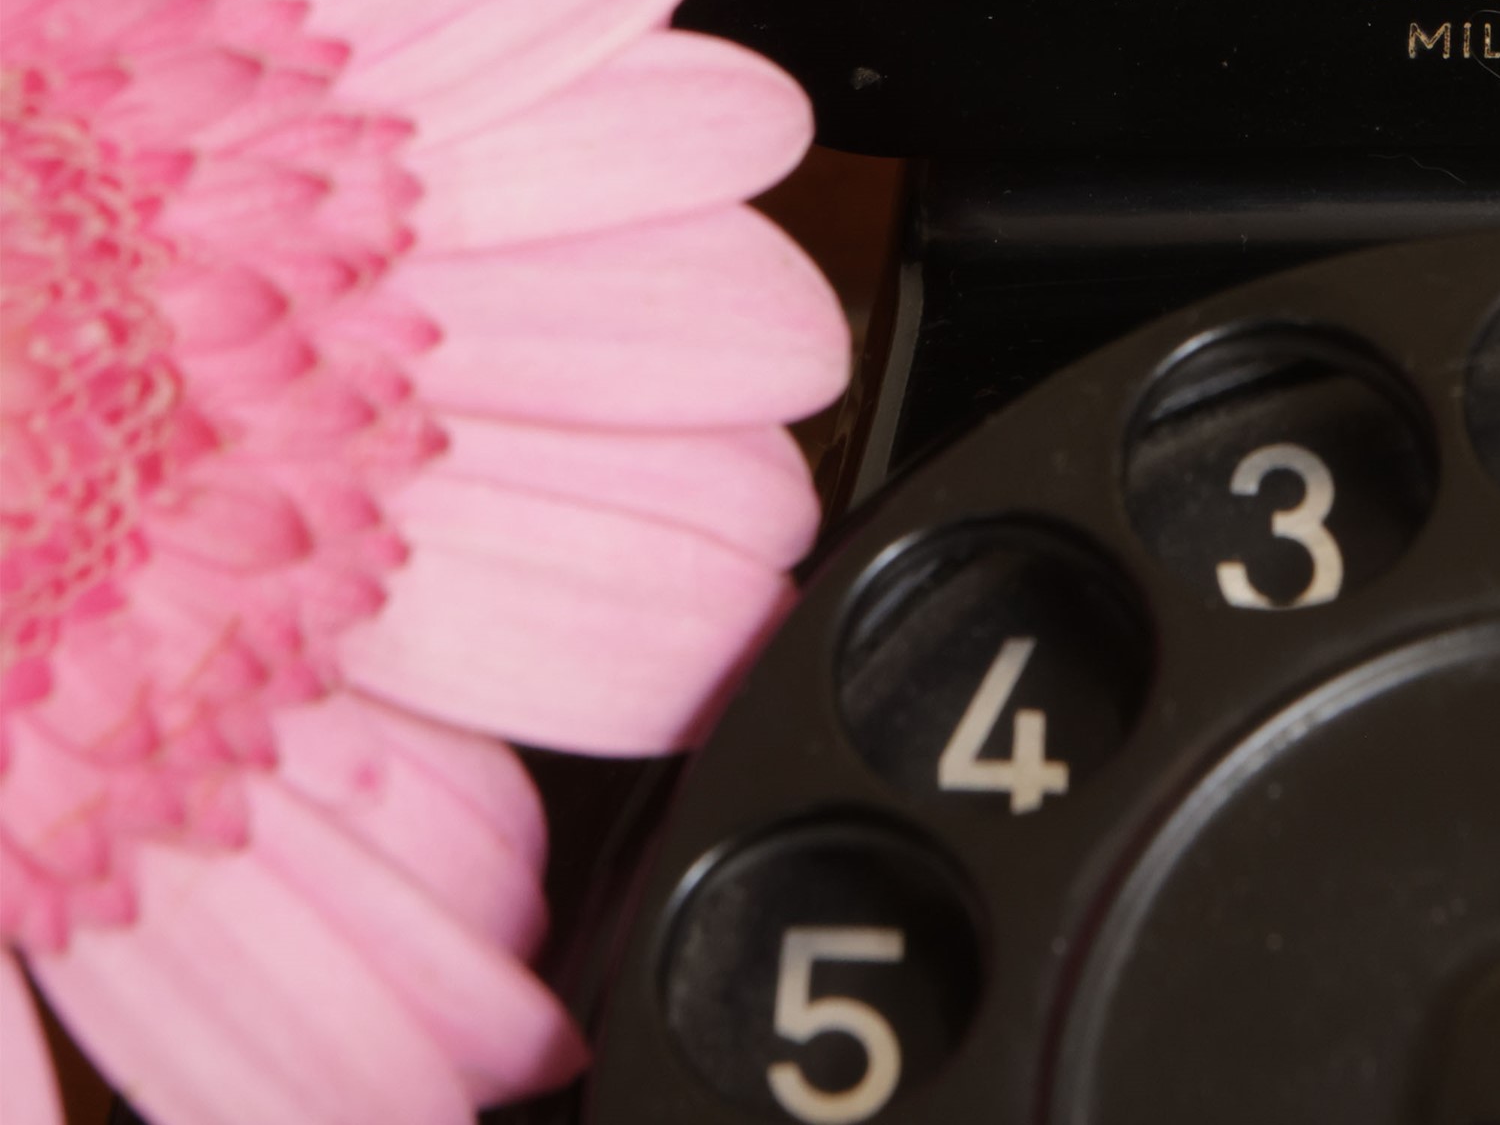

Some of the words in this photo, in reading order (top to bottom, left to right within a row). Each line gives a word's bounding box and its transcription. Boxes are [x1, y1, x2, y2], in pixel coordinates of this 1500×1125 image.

[1217, 445, 1344, 611] 3
[937, 640, 1068, 813] 4
[769, 929, 903, 1124] 5
